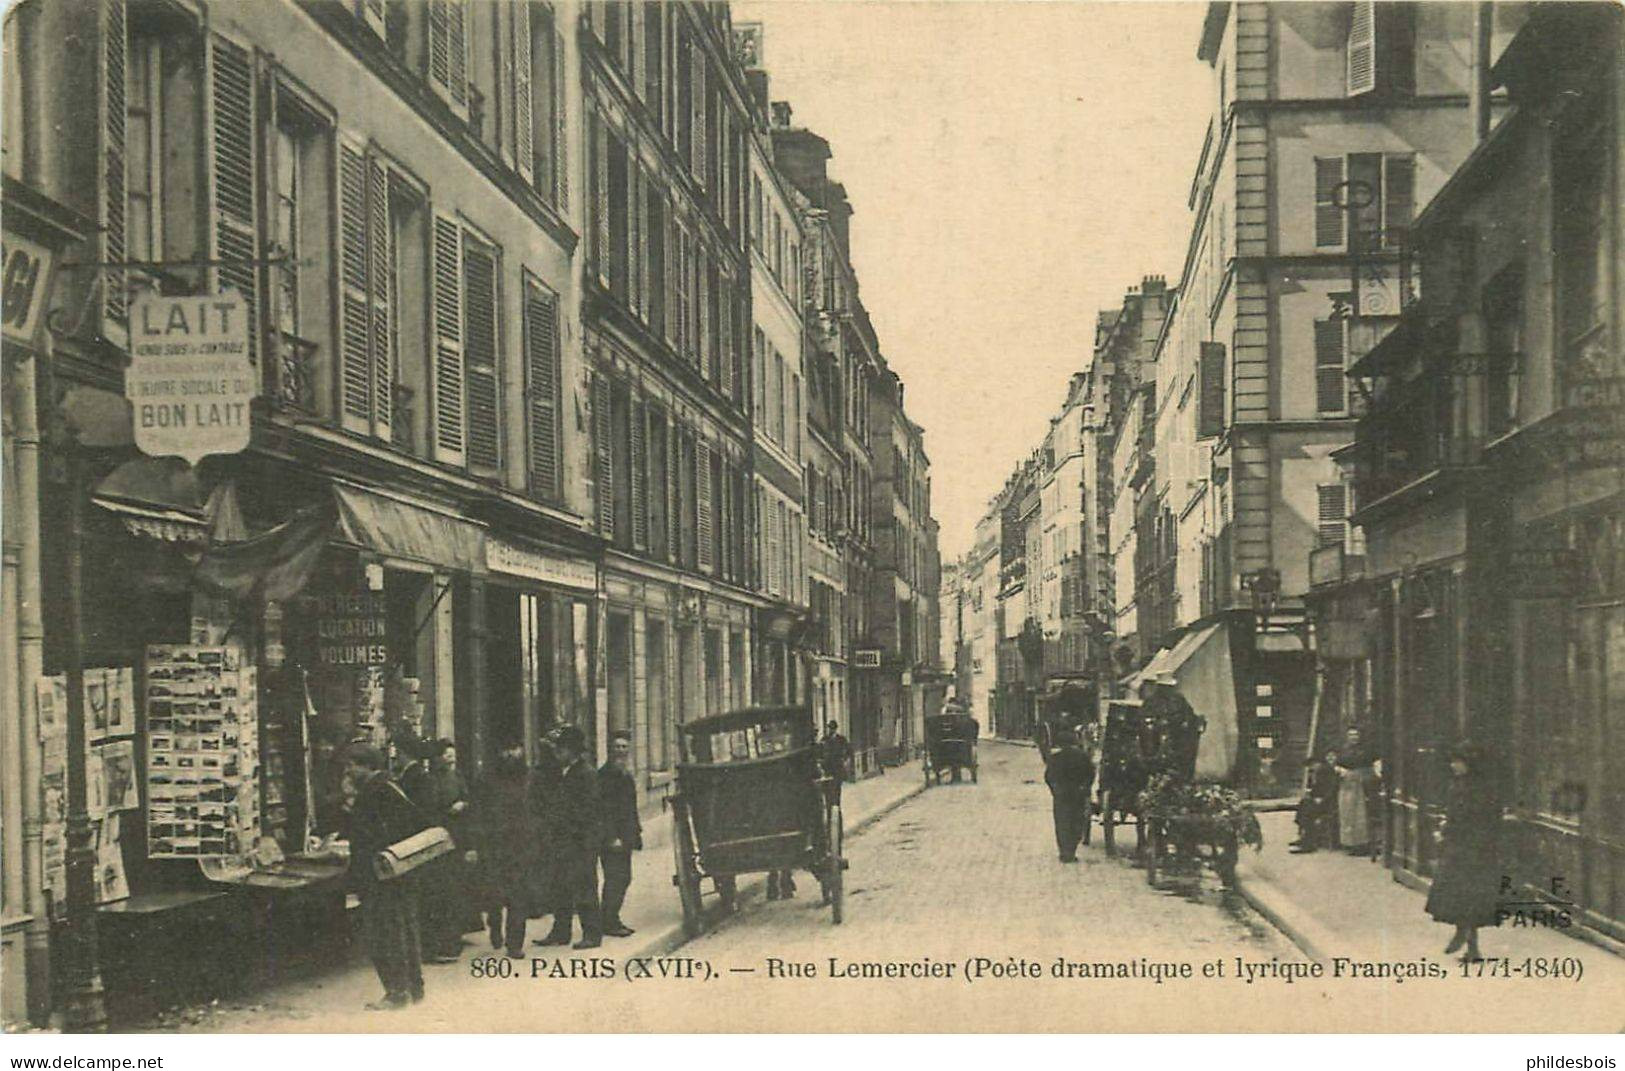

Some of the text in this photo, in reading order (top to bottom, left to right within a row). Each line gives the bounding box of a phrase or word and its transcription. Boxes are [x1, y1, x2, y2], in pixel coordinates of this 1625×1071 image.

[142, 302, 237, 335] LAIT
[142, 402, 245, 428] BON LAIT
[318, 617, 386, 638] LOCATION
[319, 645, 387, 664] VOLUMES
